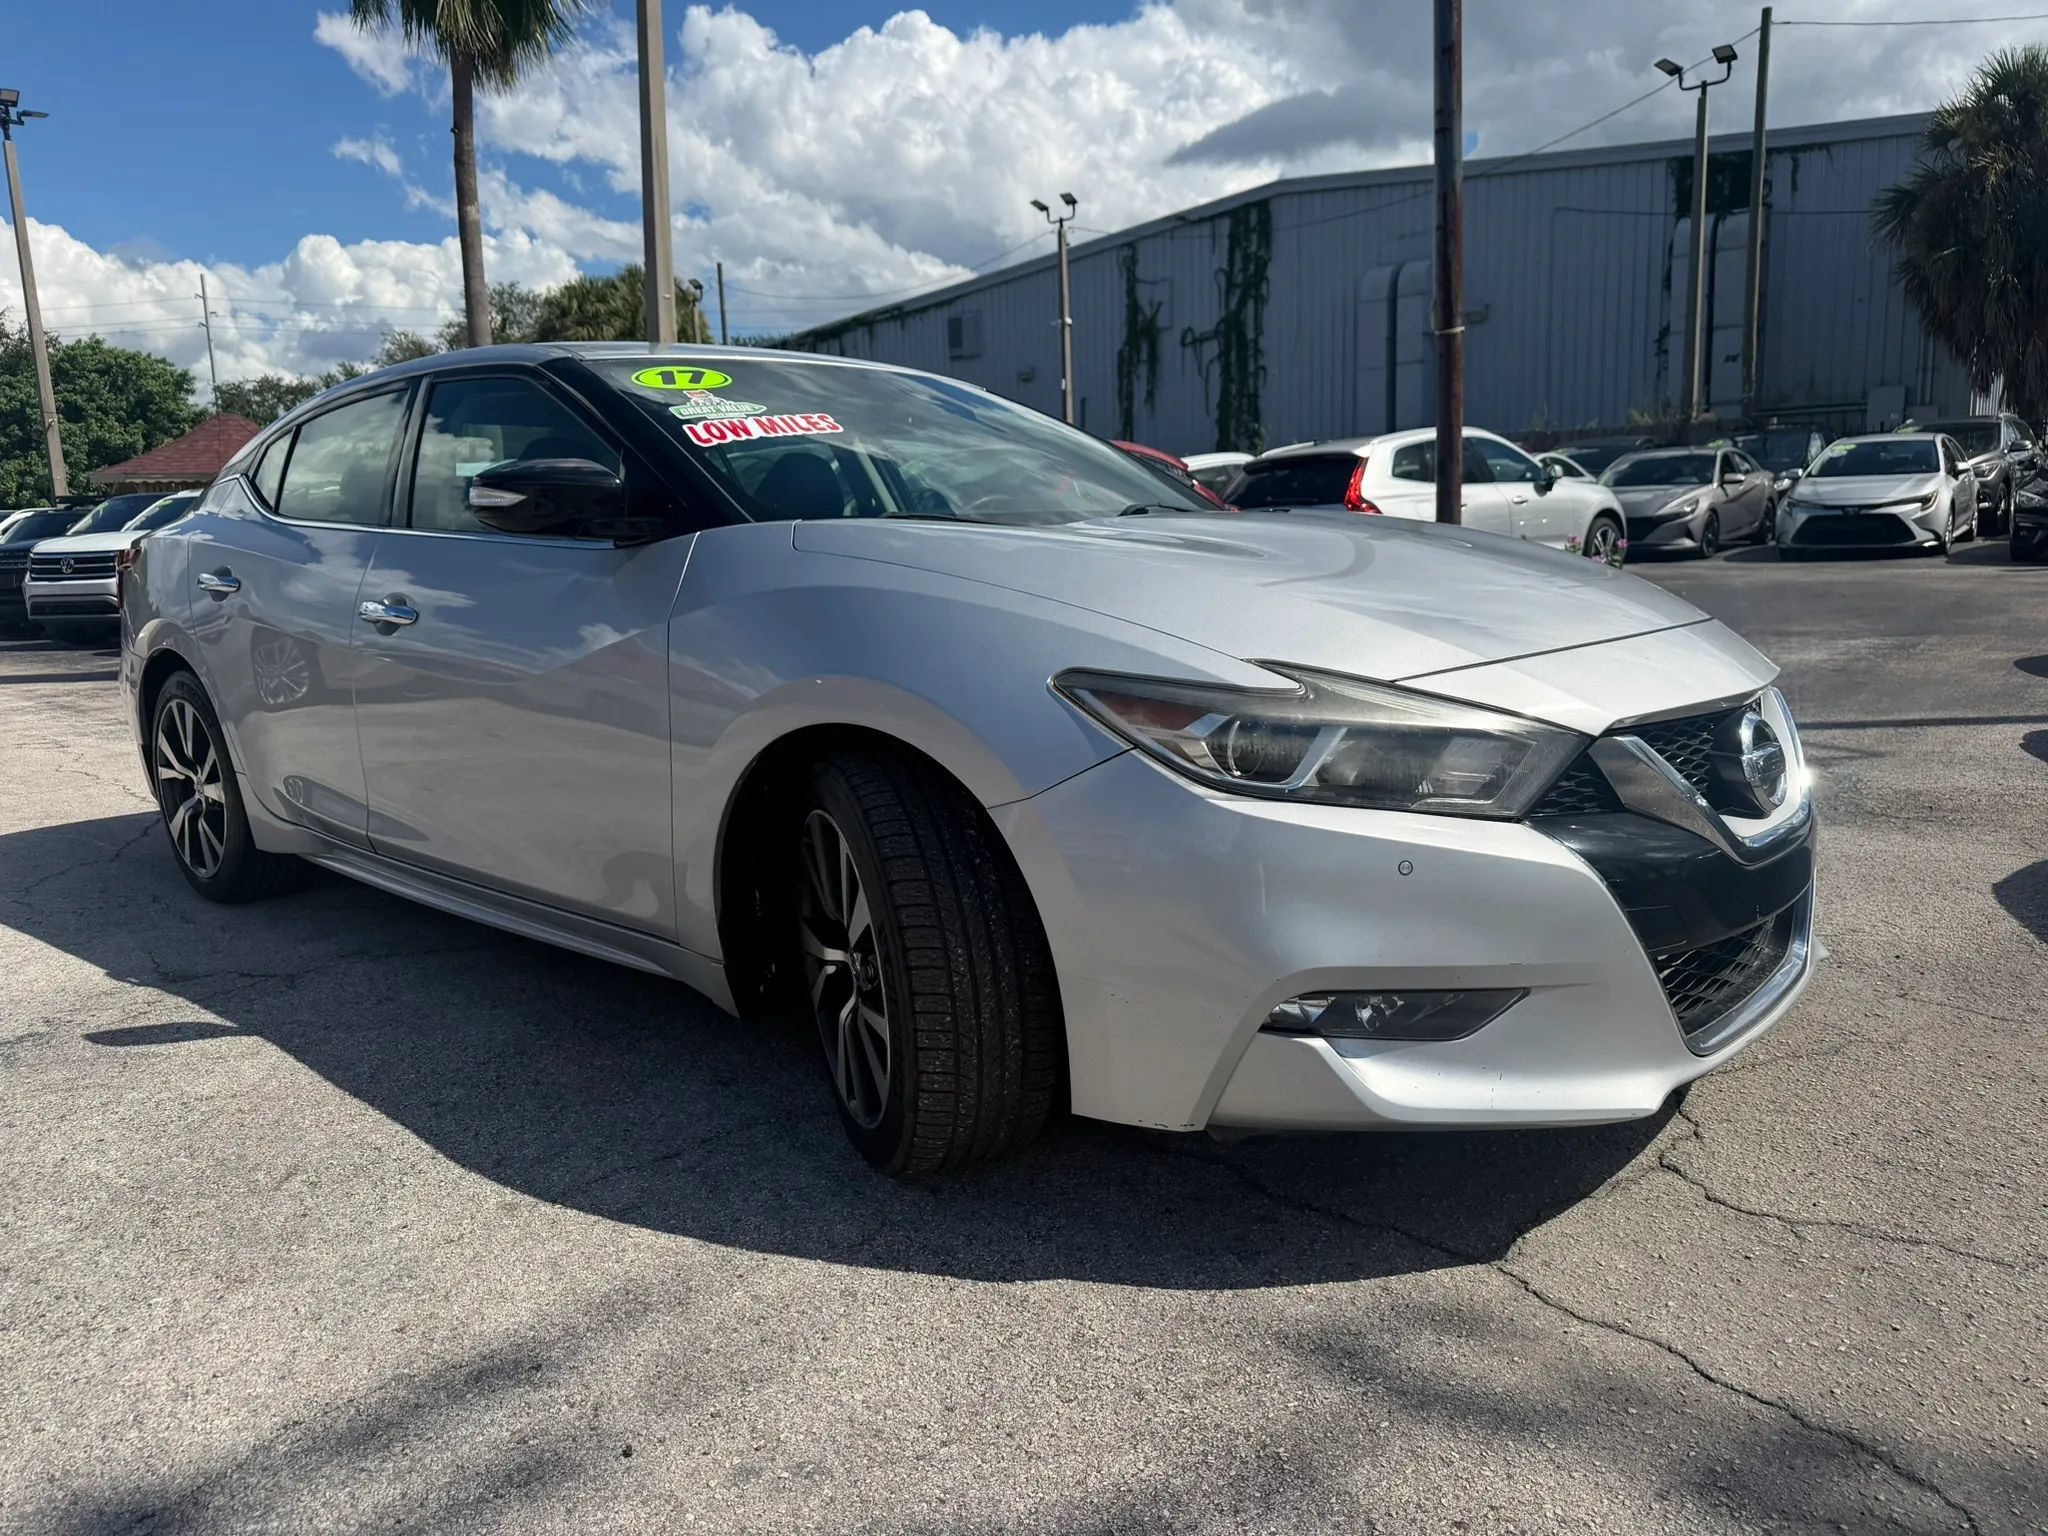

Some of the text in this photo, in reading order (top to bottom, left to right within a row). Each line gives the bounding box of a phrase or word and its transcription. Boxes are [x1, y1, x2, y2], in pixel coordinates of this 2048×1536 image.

[654, 370, 706, 385] 17
[680, 405, 716, 416] GREAT
[718, 404, 753, 413] VALUE
[687, 414, 840, 444] LOW MILES
